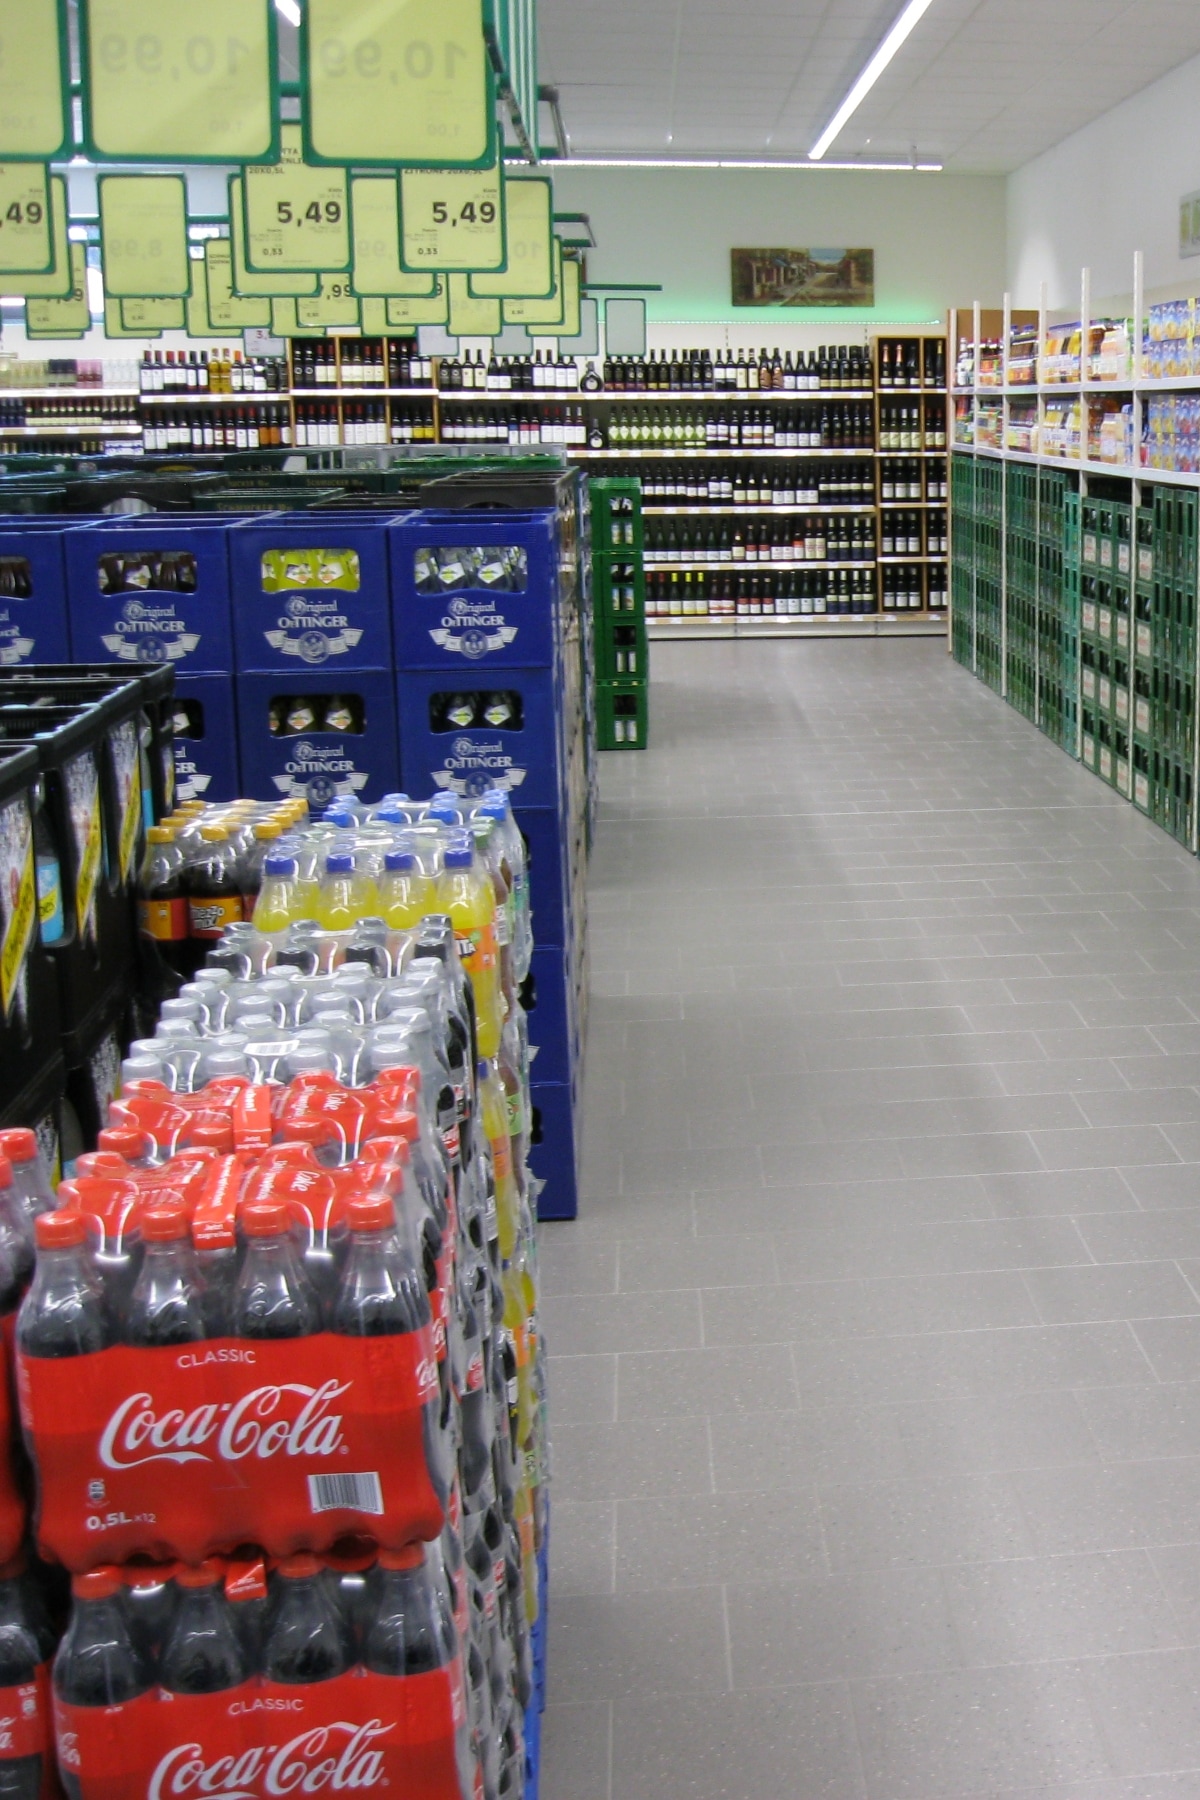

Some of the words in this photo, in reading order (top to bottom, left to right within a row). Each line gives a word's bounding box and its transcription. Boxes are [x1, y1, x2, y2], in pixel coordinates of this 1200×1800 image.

[0, 202, 43, 228] ,49
[277, 201, 342, 227] 5,49
[432, 201, 496, 227] 5,49
[123, 600, 176, 621] Original
[286, 596, 338, 617] Original
[448, 597, 497, 615] Original
[292, 741, 344, 760] Original
[451, 737, 503, 756] Original
[177, 1350, 256, 1369] CLASSIC
[100, 1378, 353, 1470] Coca-Cola
[86, 1513, 132, 1531] 0,5L
[134, 1513, 156, 1524] x12
[228, 1698, 304, 1716] CLASSIC
[149, 1718, 398, 1800] Coca-Cola
